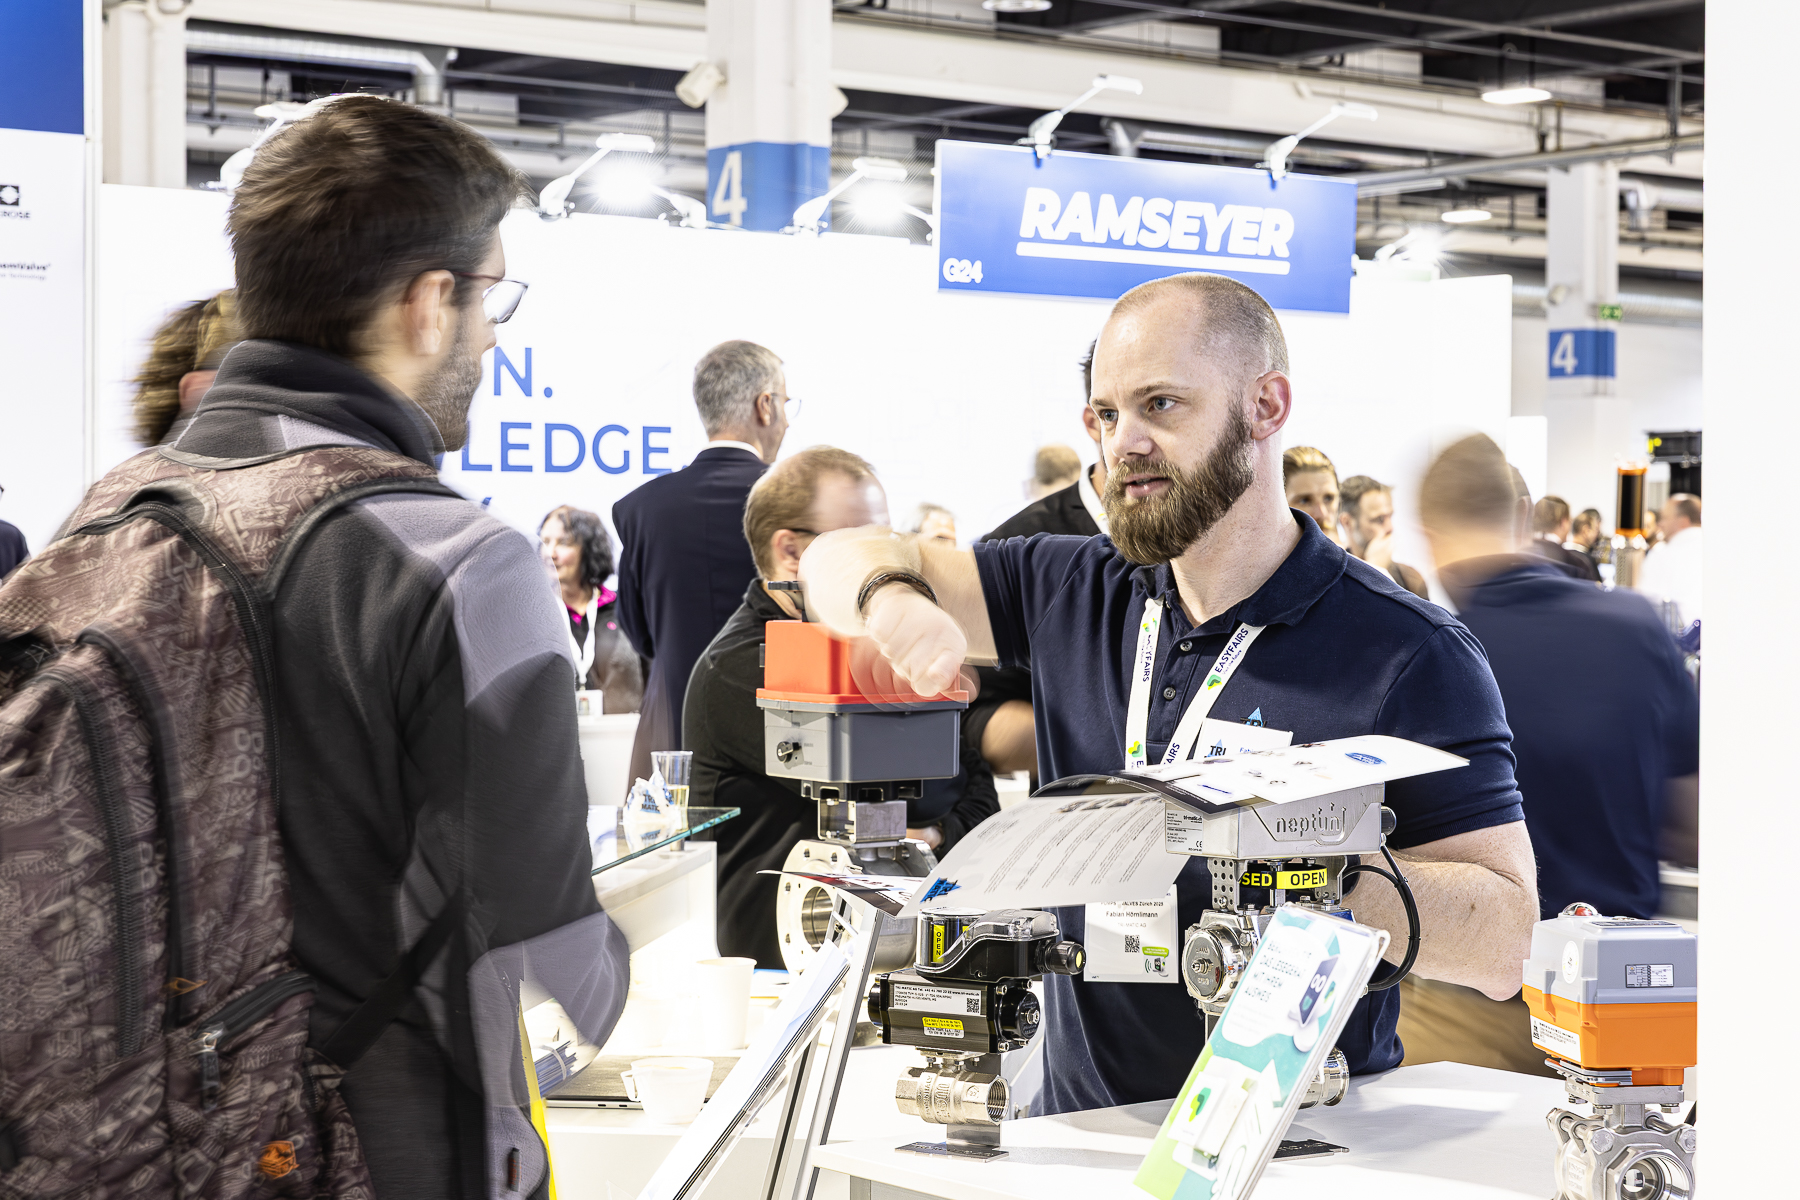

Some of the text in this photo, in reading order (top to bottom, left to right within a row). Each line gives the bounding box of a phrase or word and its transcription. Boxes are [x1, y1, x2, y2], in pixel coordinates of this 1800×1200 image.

[712, 151, 747, 226] 4
[1020, 187, 1294, 257] RAMSEYER
[943, 257, 983, 284] G24
[1552, 333, 1577, 375] 4
[1215, 628, 1248, 673] EASYFAIRS
[1210, 746, 1226, 756] TRI
[1291, 871, 1325, 886] OPEN
